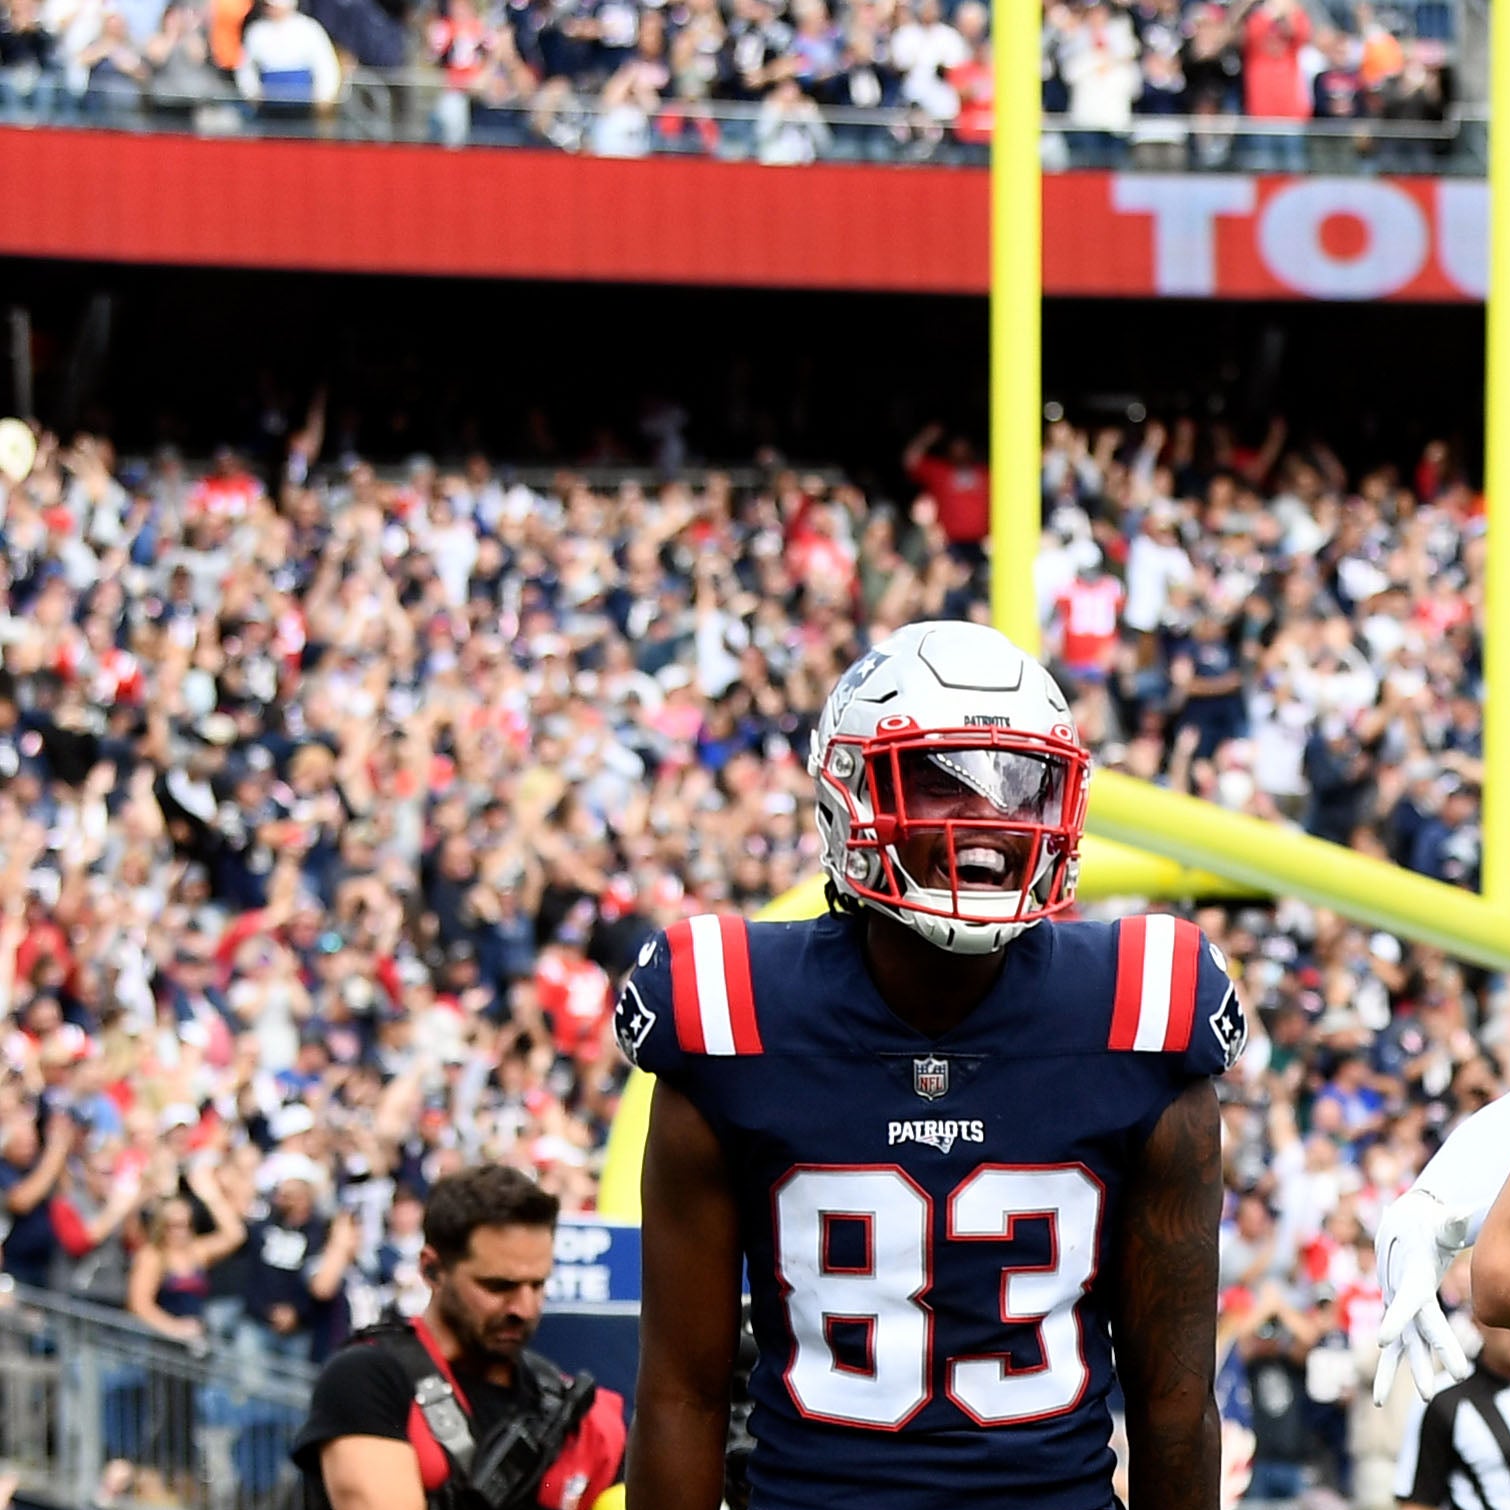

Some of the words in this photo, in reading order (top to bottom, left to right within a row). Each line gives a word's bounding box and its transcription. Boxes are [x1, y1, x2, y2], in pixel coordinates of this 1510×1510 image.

[888, 1119, 984, 1146] PATRIOTS
[555, 1228, 613, 1264] OP
[769, 1161, 1107, 1433] 83
